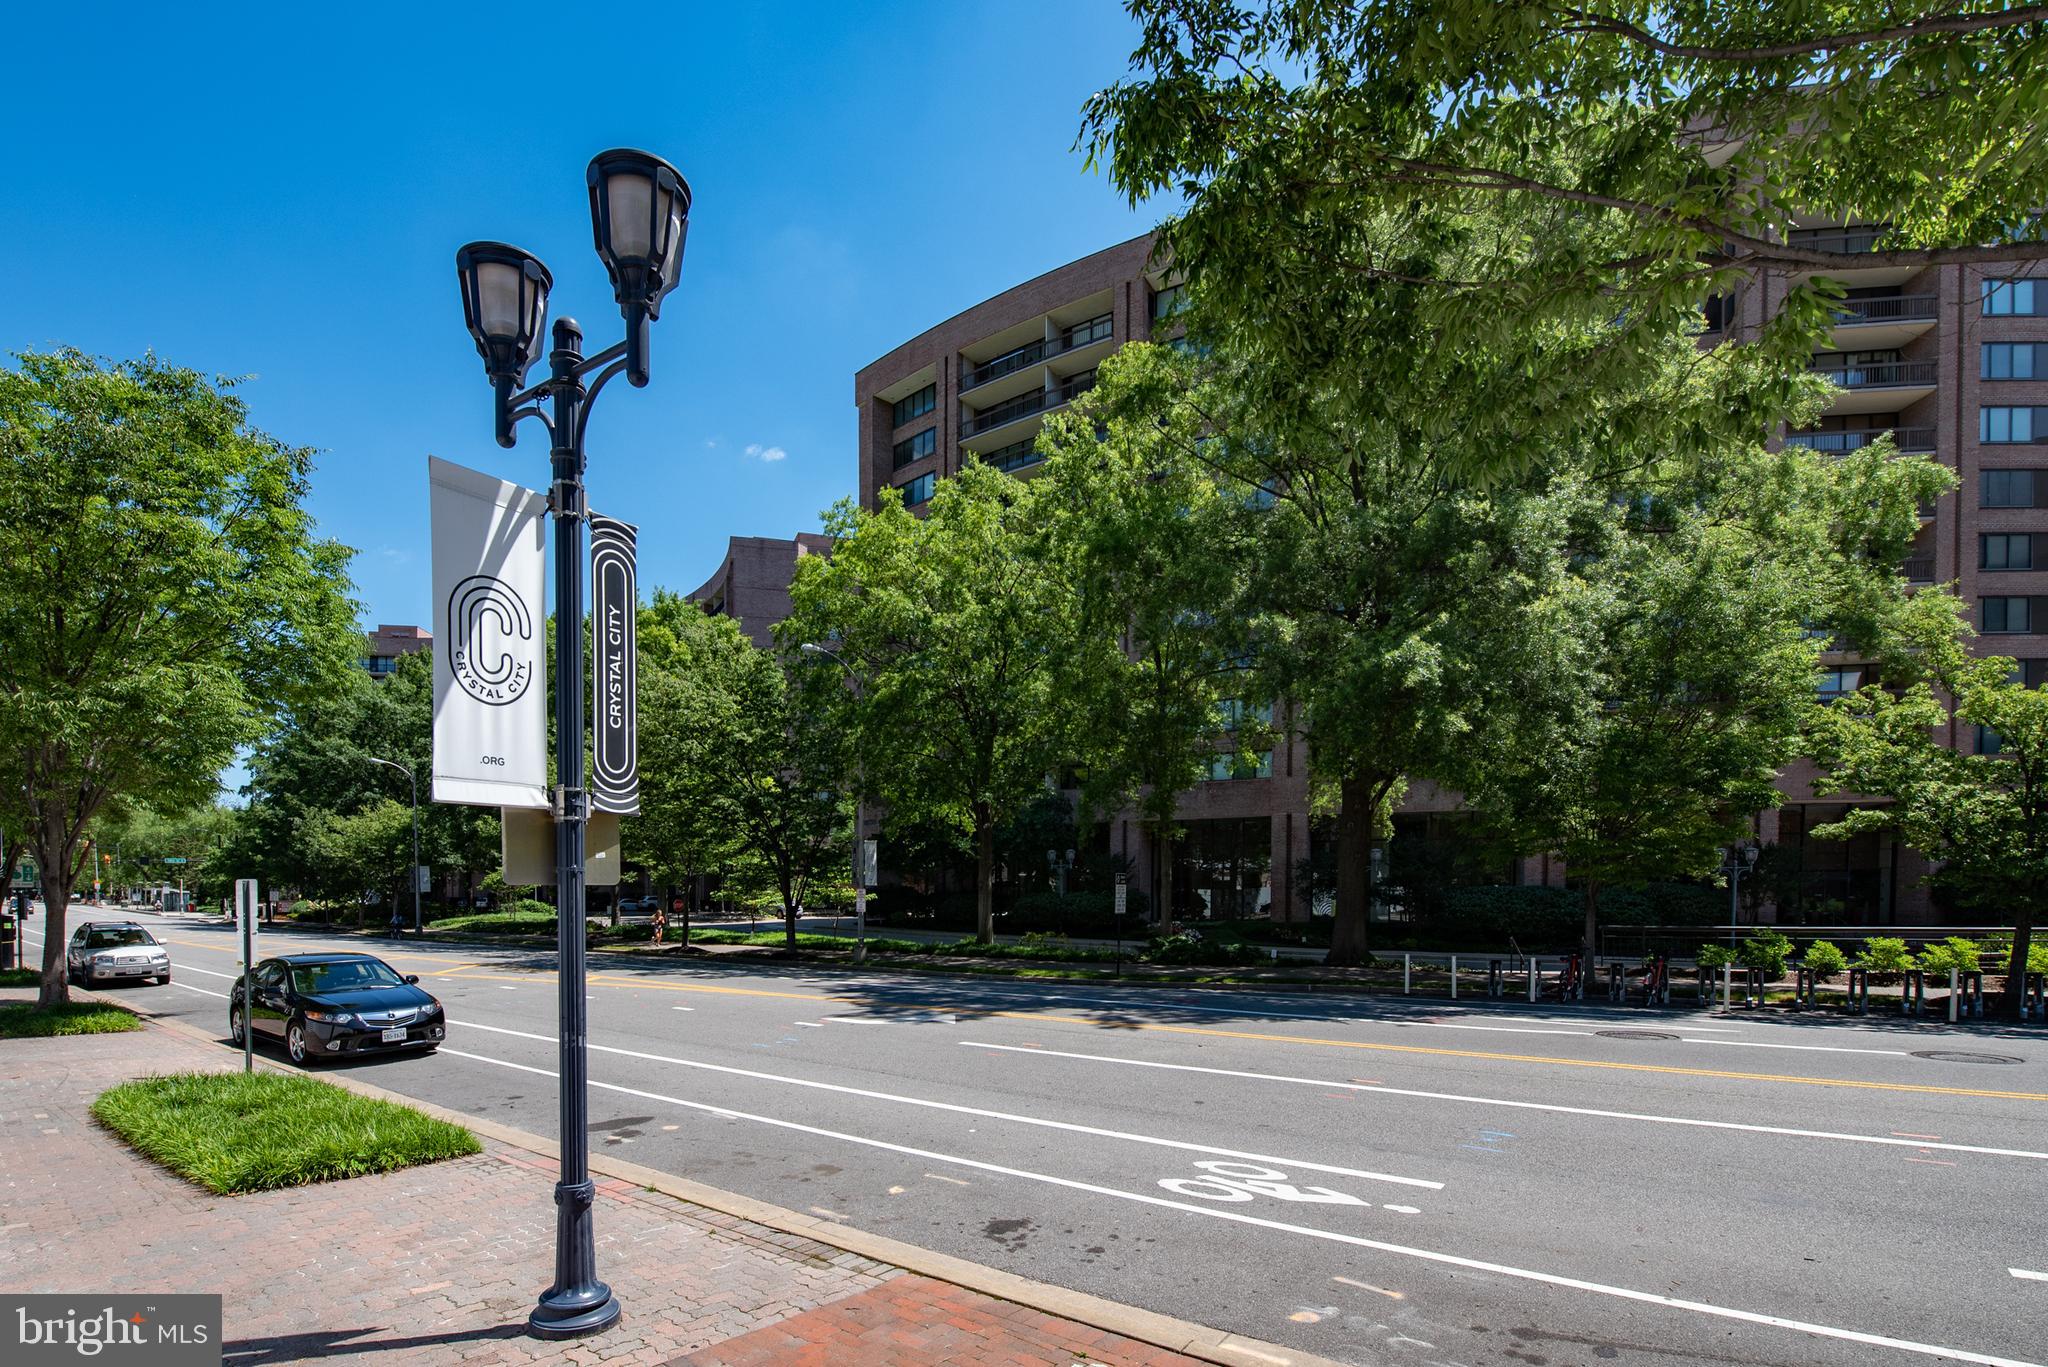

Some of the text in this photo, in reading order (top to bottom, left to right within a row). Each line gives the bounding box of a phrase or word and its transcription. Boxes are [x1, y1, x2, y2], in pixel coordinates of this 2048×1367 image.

[456, 651, 526, 699] CRYSTAL CITY
[609, 604, 622, 729] CRYSTAL CITY
[480, 755, 505, 766] .ORG
